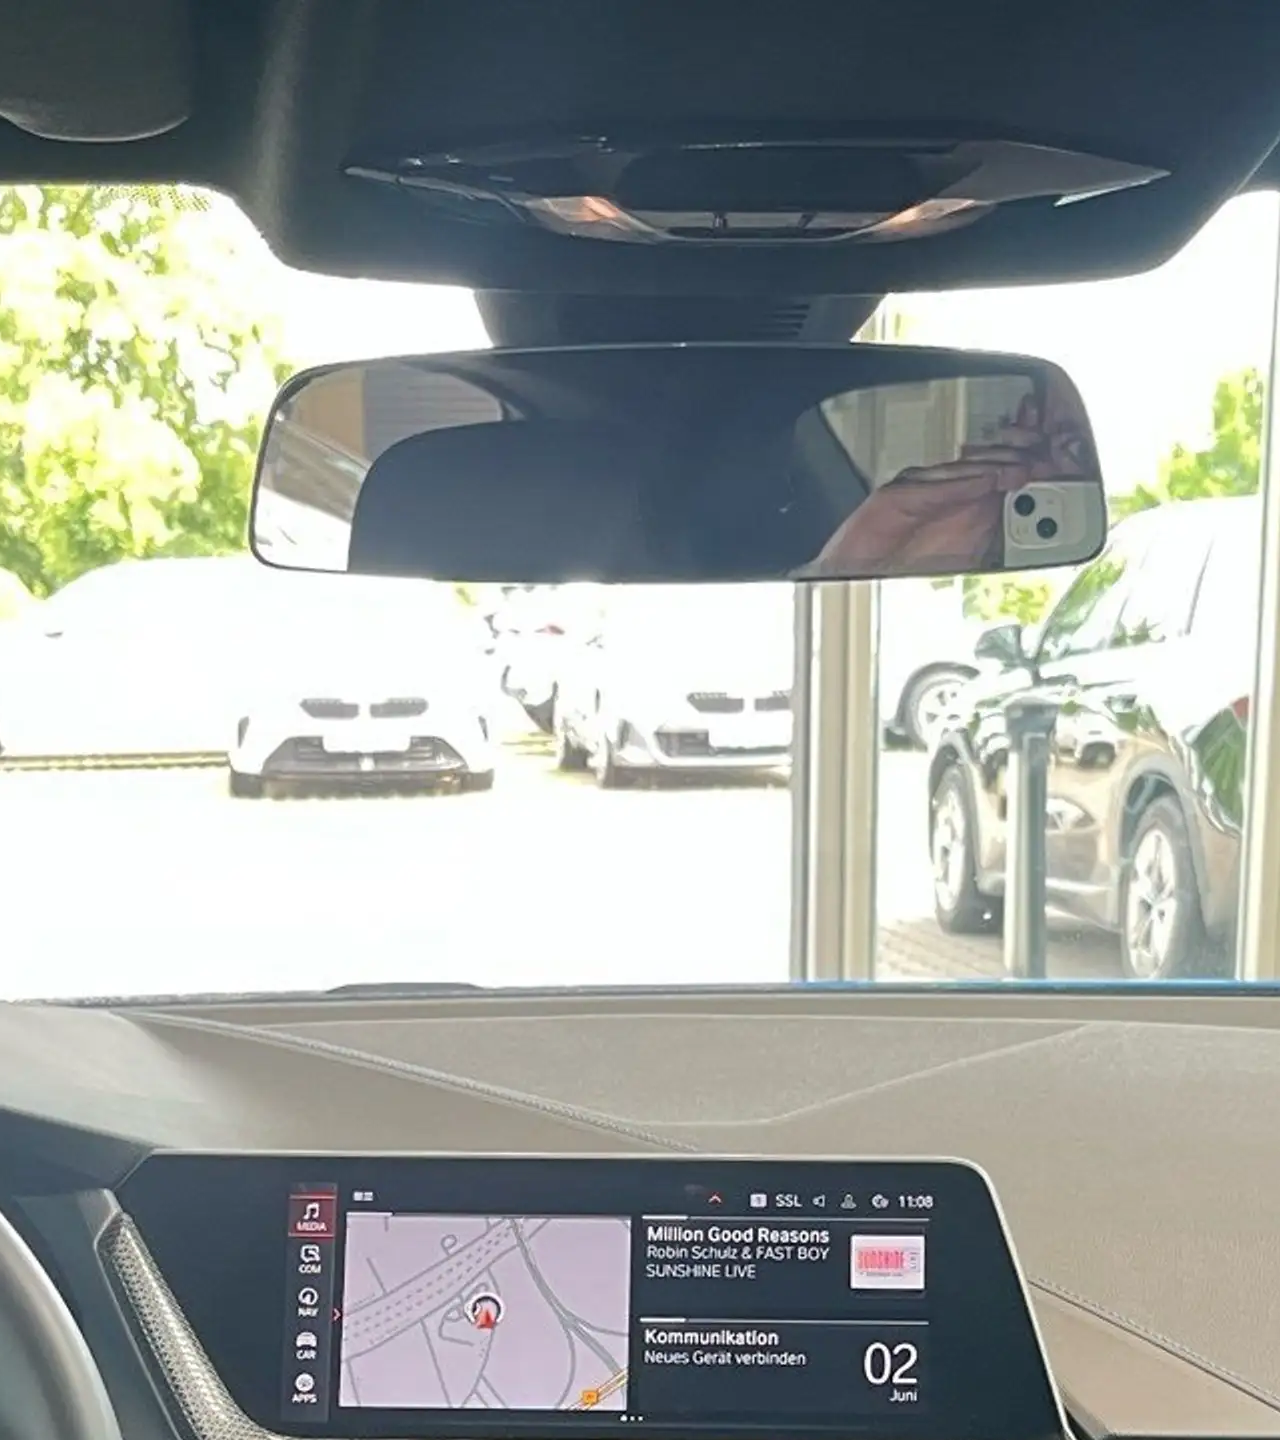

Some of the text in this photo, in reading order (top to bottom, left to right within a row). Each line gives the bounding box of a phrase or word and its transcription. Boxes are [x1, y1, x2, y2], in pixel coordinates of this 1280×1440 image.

[775, 1194, 803, 1208] SSL
[898, 1195, 933, 1208] 11:08
[295, 1221, 327, 1232] MEDIA
[646, 1226, 830, 1244] Million Good Reasons
[646, 1246, 829, 1260] Robin Schulz & FAST BOY
[298, 1263, 322, 1274] COM
[645, 1264, 757, 1279] SUNSHINE LIVE
[298, 1307, 320, 1318] NAV
[643, 1328, 780, 1346] Kommunikation
[295, 1349, 317, 1360] CAR
[643, 1351, 690, 1364] Neues
[733, 1351, 807, 1366] verbinden
[863, 1342, 918, 1385] 02
[291, 1393, 317, 1404] APPS
[889, 1389, 918, 1403] Juni
